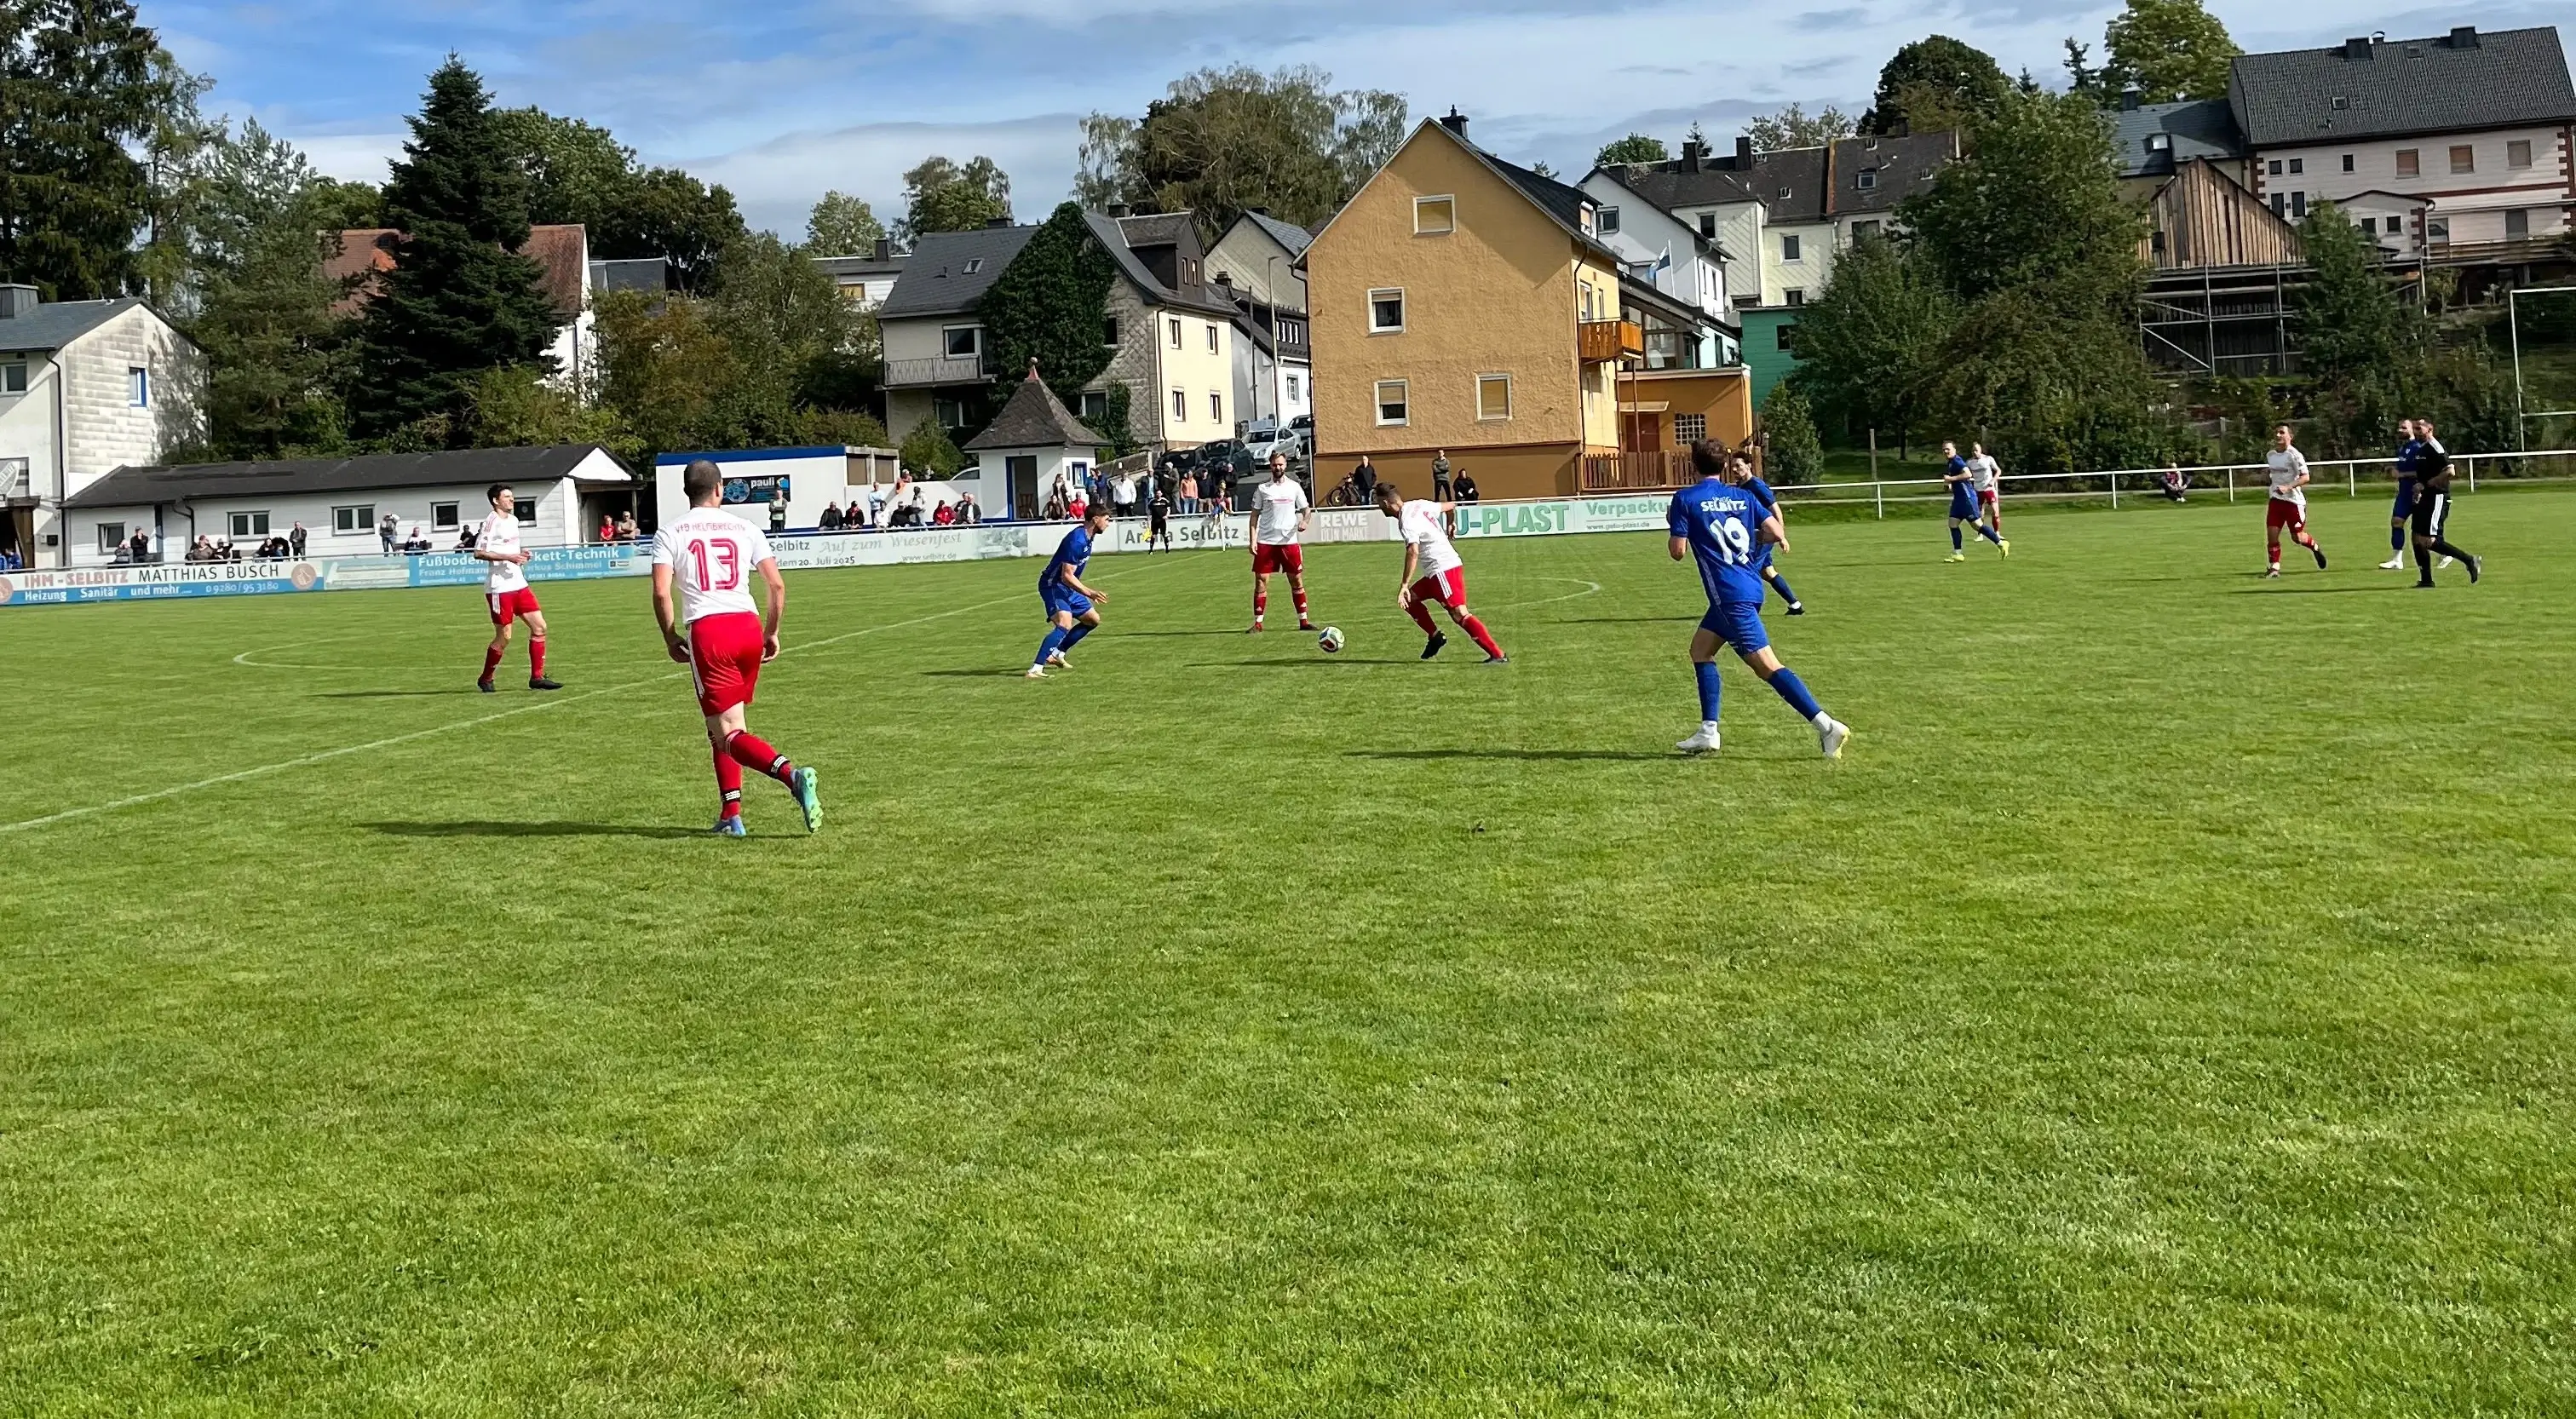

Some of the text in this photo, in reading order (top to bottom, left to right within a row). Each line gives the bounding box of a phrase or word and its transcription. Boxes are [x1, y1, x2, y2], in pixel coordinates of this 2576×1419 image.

[750, 477, 775, 489] pauli
[1699, 500, 1747, 512] SELBITZ
[1320, 513, 1368, 527] REWE
[1439, 504, 1570, 536] U-PLAST
[1124, 529, 1173, 543] Arna
[1710, 516, 1750, 565] 19
[769, 540, 810, 552] Selbitz
[819, 532, 962, 555] Auf zum Wiesenfest
[528, 547, 620, 561] kett-Technik
[687, 538, 739, 591] 13
[777, 557, 797, 567] dem
[815, 556, 831, 566] Juli
[835, 556, 855, 565] 2025
[138, 564, 279, 582] MATTHIAS BUSCH
[25, 590, 66, 601] Heizung
[80, 587, 118, 598] Sanitär
[130, 584, 150, 595] und
